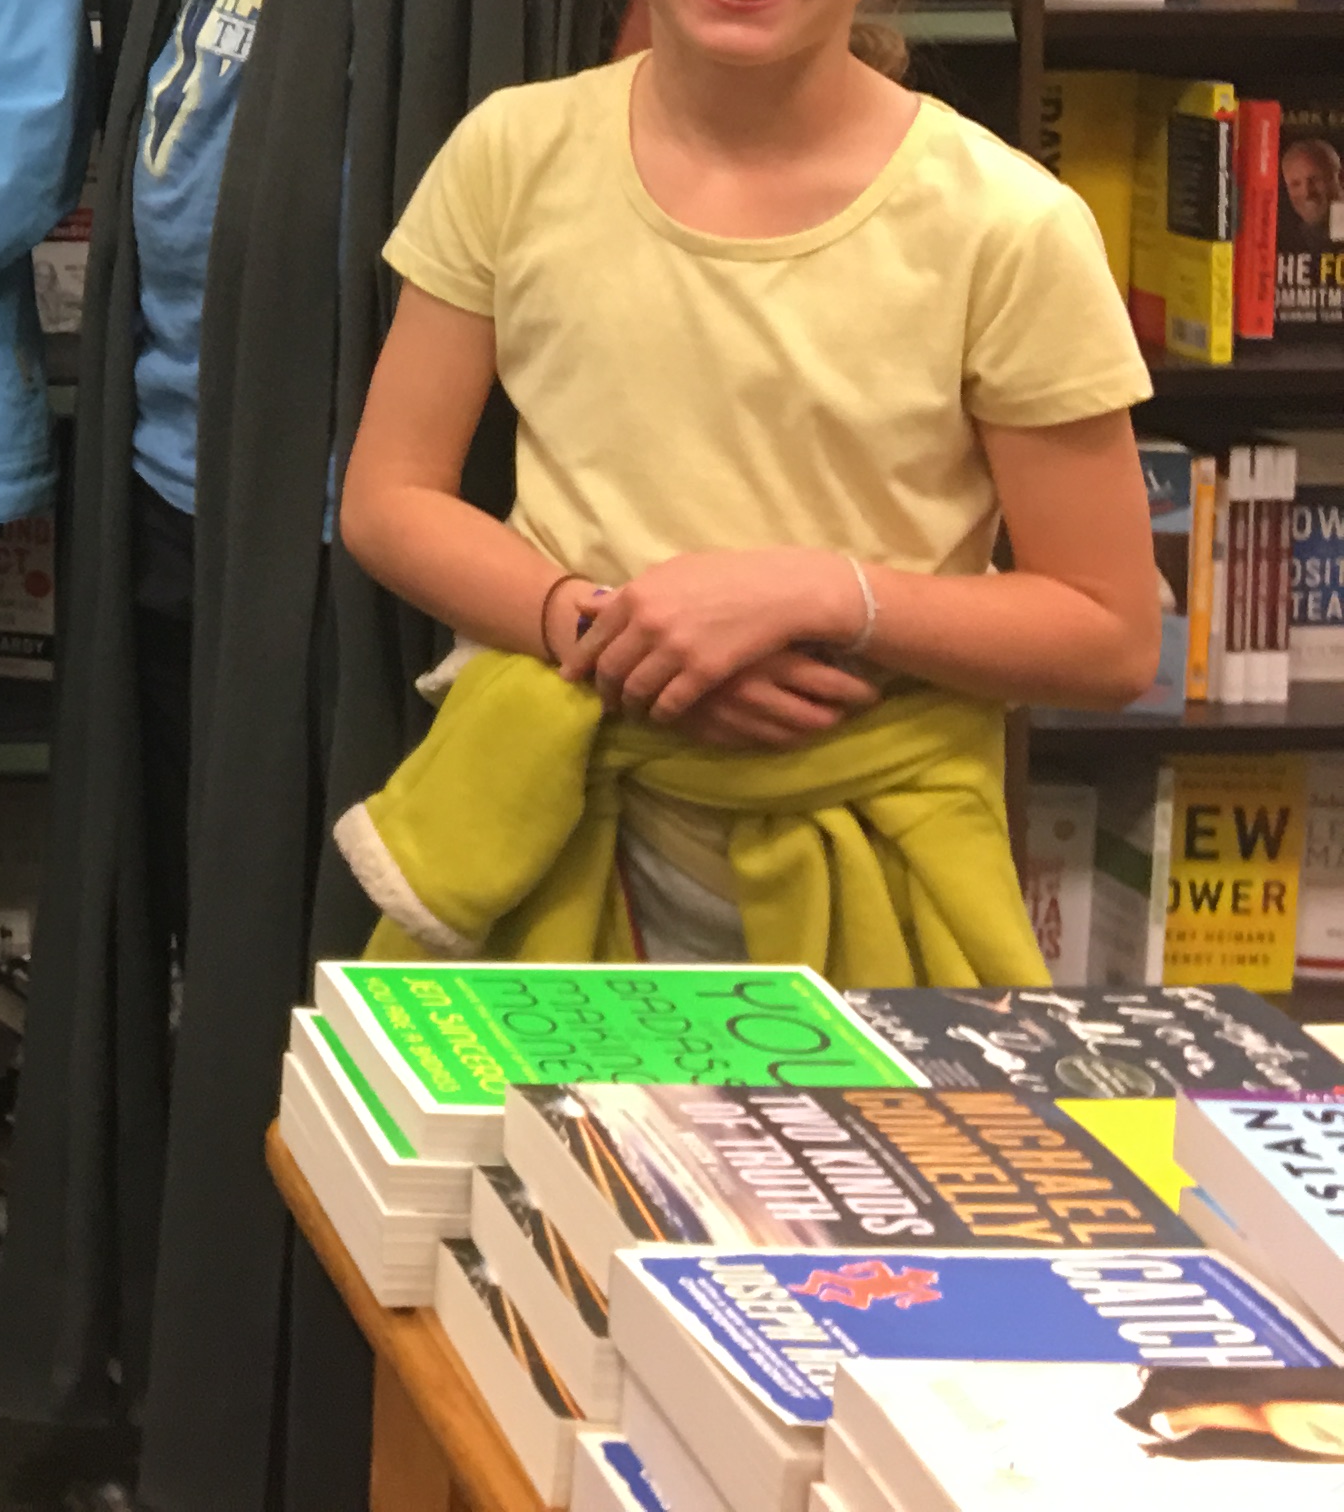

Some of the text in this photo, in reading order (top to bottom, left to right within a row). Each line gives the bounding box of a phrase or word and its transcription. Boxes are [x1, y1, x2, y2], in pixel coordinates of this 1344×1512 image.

[401, 975, 453, 1009] JEN
[678, 1101, 760, 1131] OF
[714, 1136, 842, 1224] TRUTH
[747, 1093, 851, 1143] TWO
[799, 1147, 936, 1238] KINDS
[842, 1090, 1065, 1245] CONNELLY
[934, 1090, 1157, 1246] MICHAEL
[697, 1255, 832, 1343] JOSEPH
